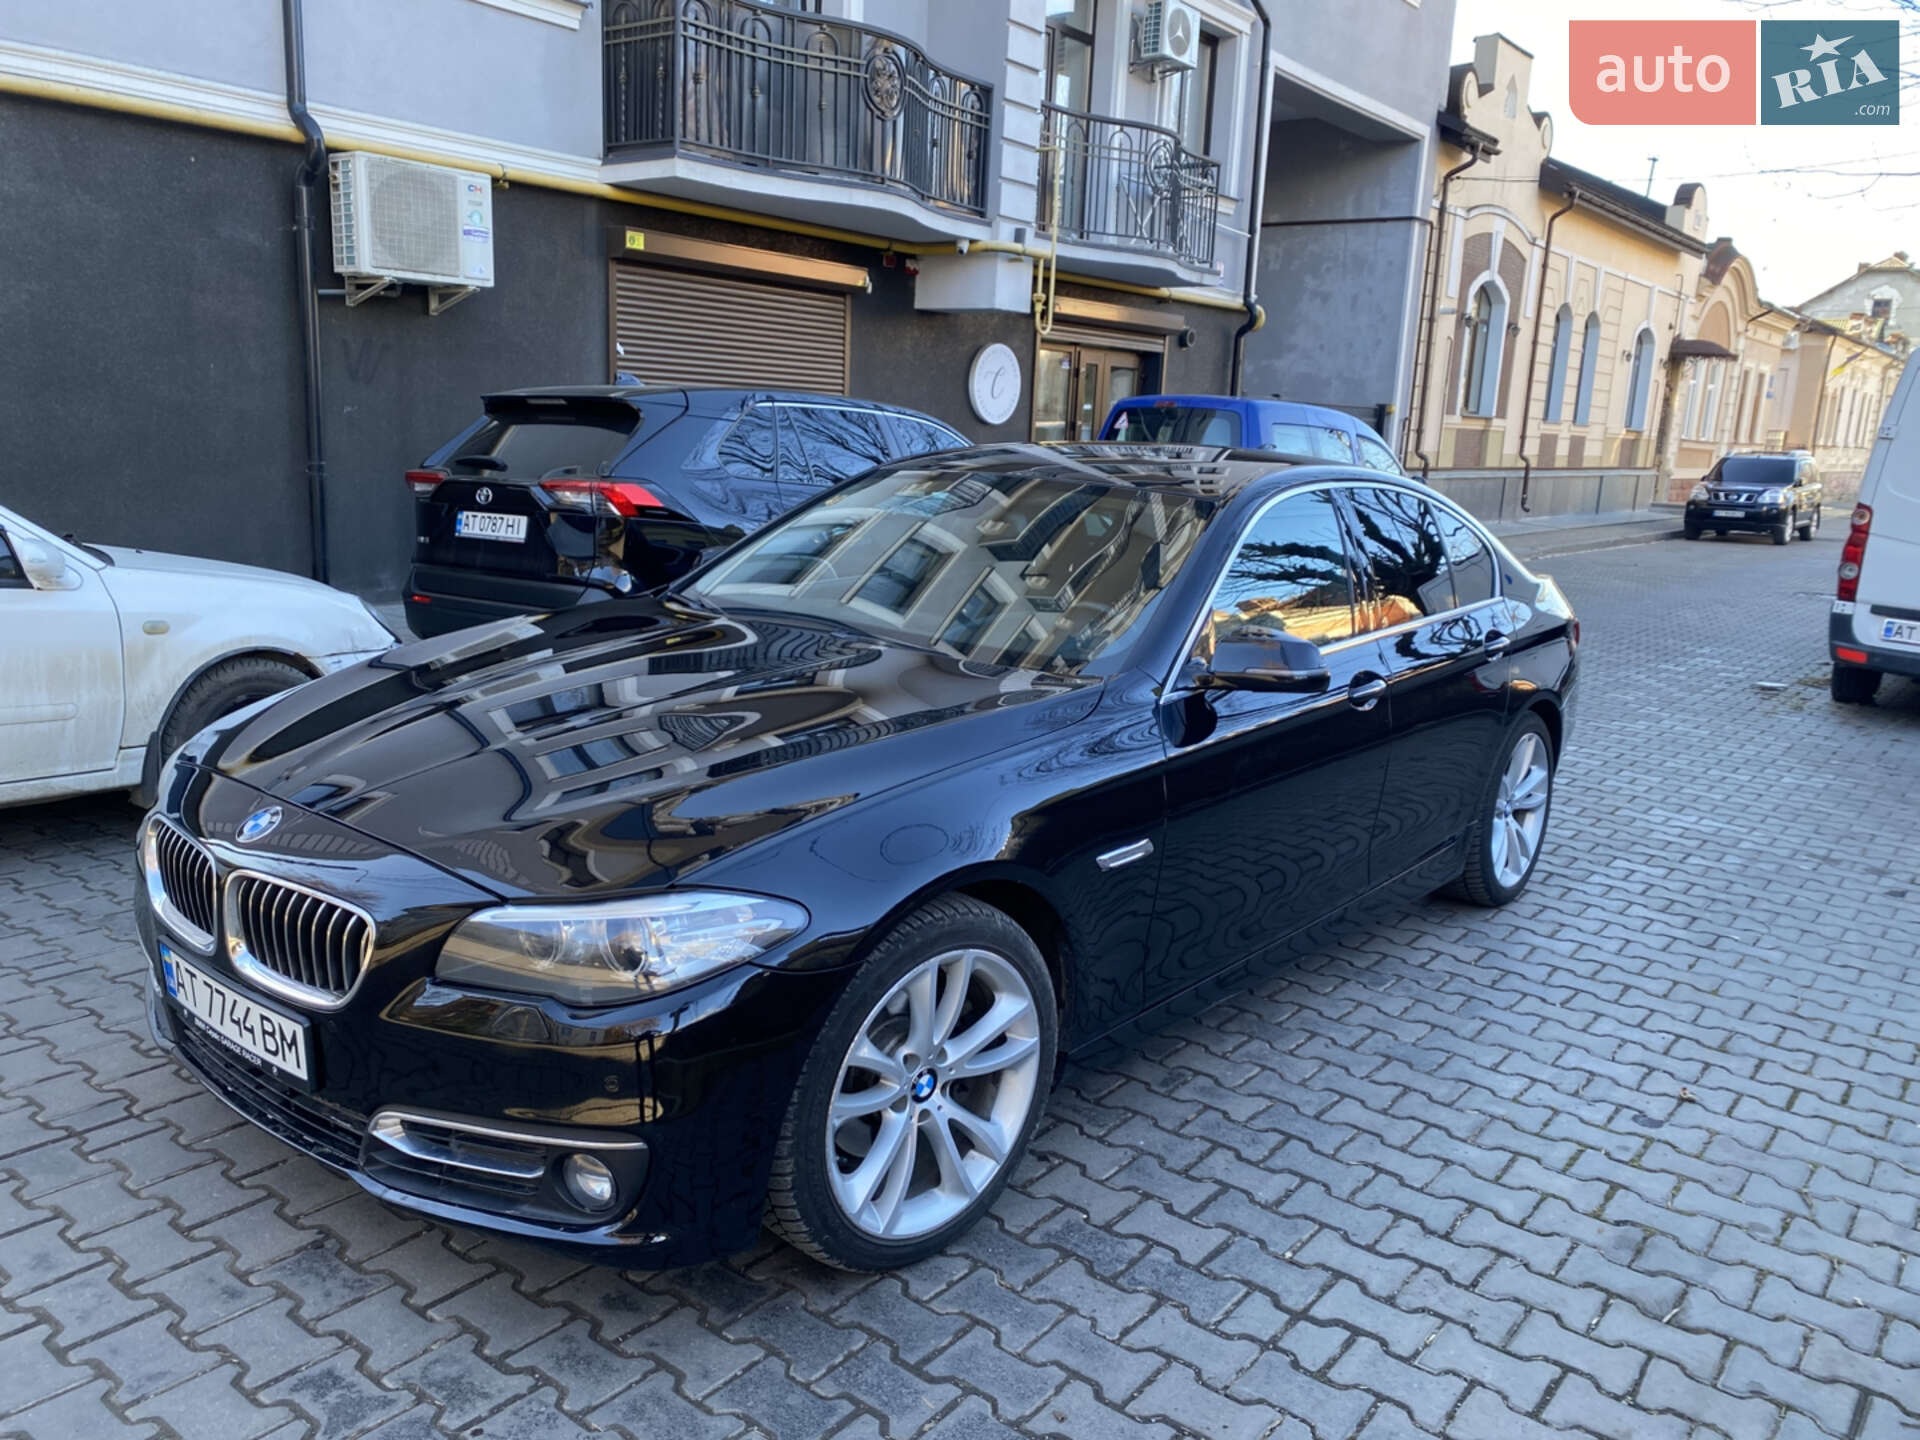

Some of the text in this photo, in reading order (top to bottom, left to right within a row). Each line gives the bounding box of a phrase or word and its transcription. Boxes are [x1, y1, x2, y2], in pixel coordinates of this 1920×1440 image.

[463, 514, 521, 535] AT 0787 HI
[1893, 625, 1917, 640] AT
[175, 961, 302, 1070] AT 7744 BM
